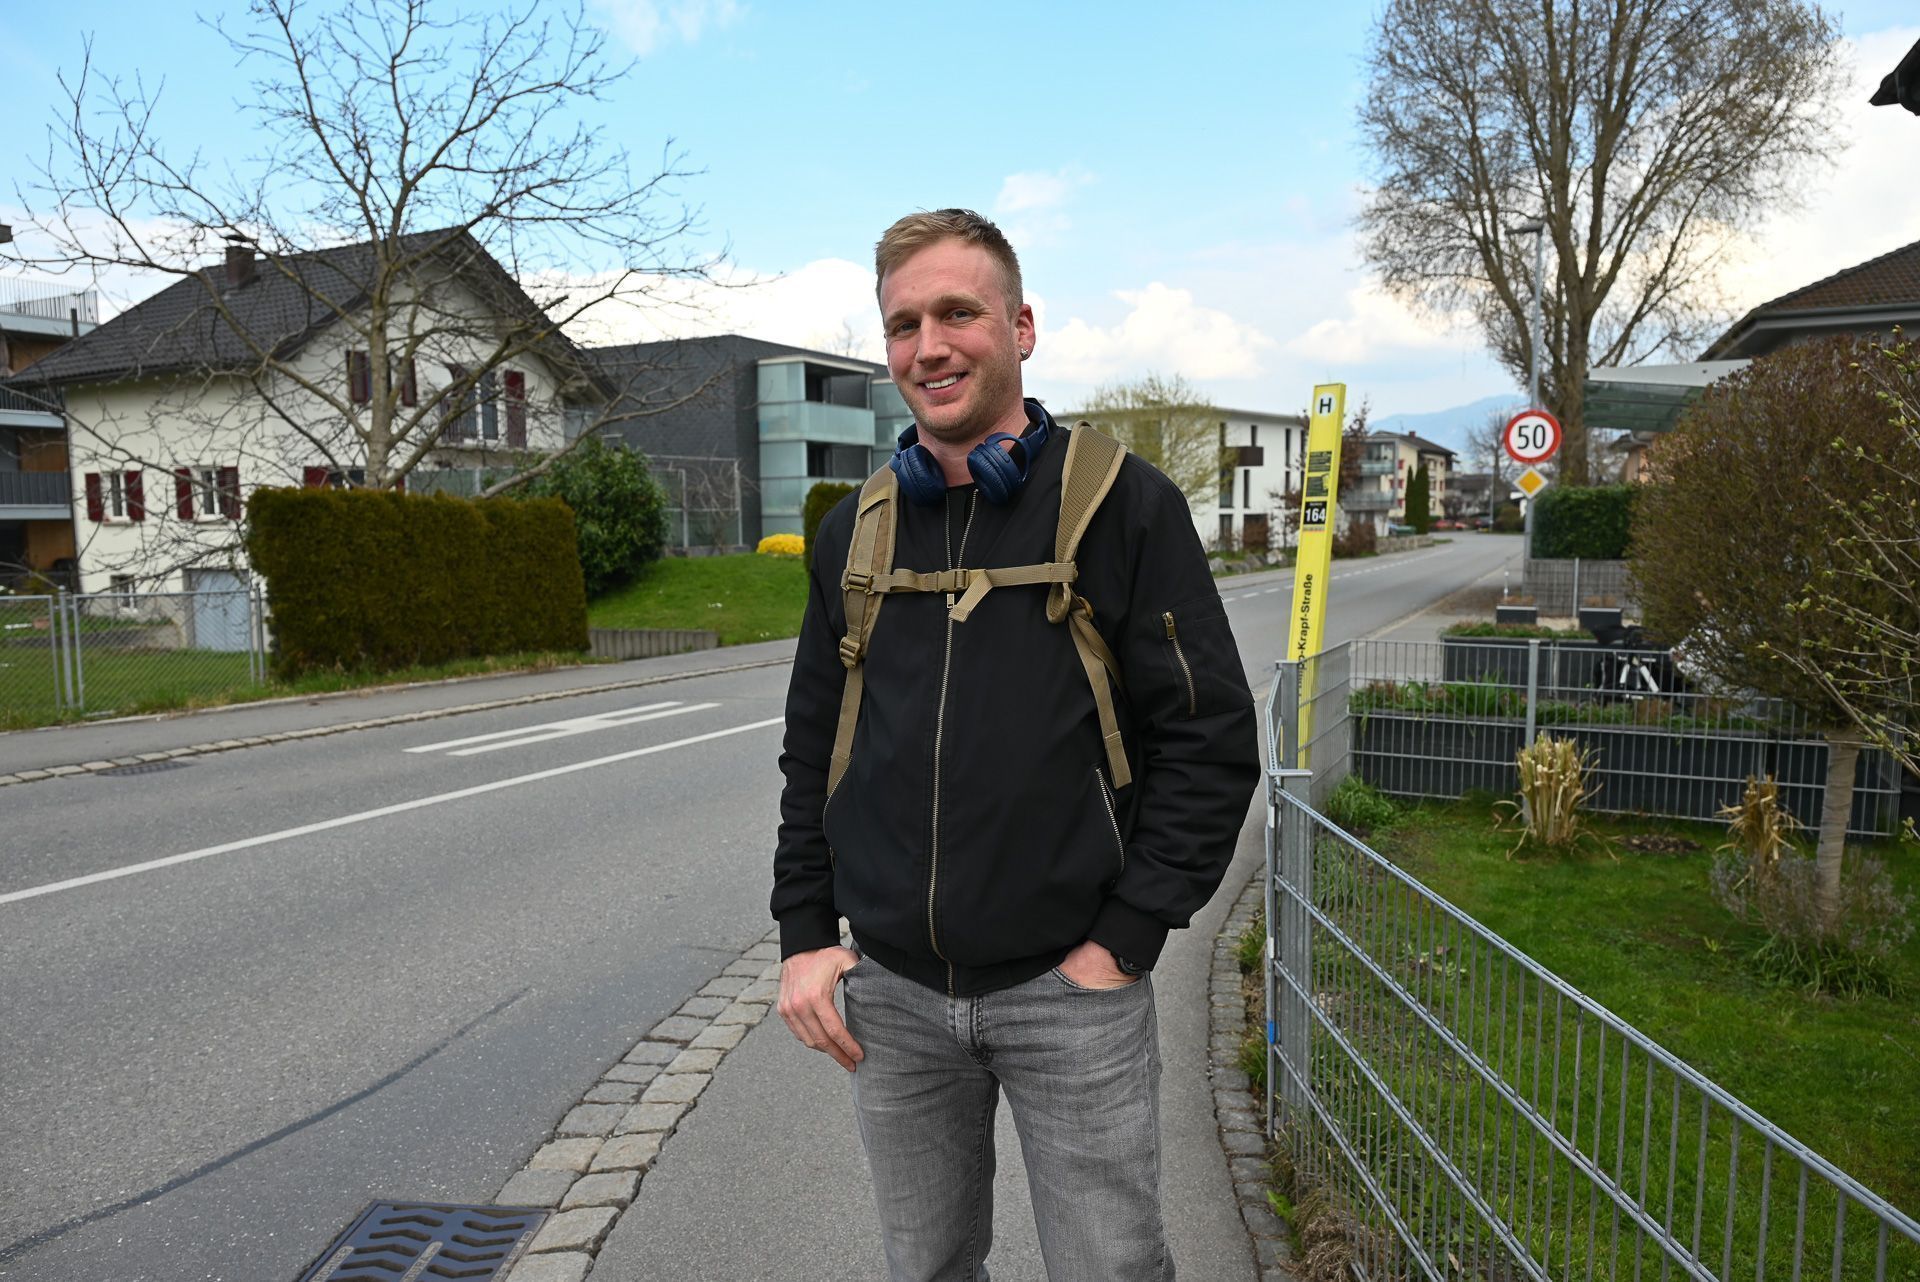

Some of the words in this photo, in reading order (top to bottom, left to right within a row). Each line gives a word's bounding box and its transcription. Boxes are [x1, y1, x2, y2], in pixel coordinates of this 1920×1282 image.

[1319, 397, 1332, 414] H
[1517, 424, 1546, 450] 50
[1305, 507, 1326, 522] 164
[1297, 573, 1313, 697] pp-Krapf-Straße
